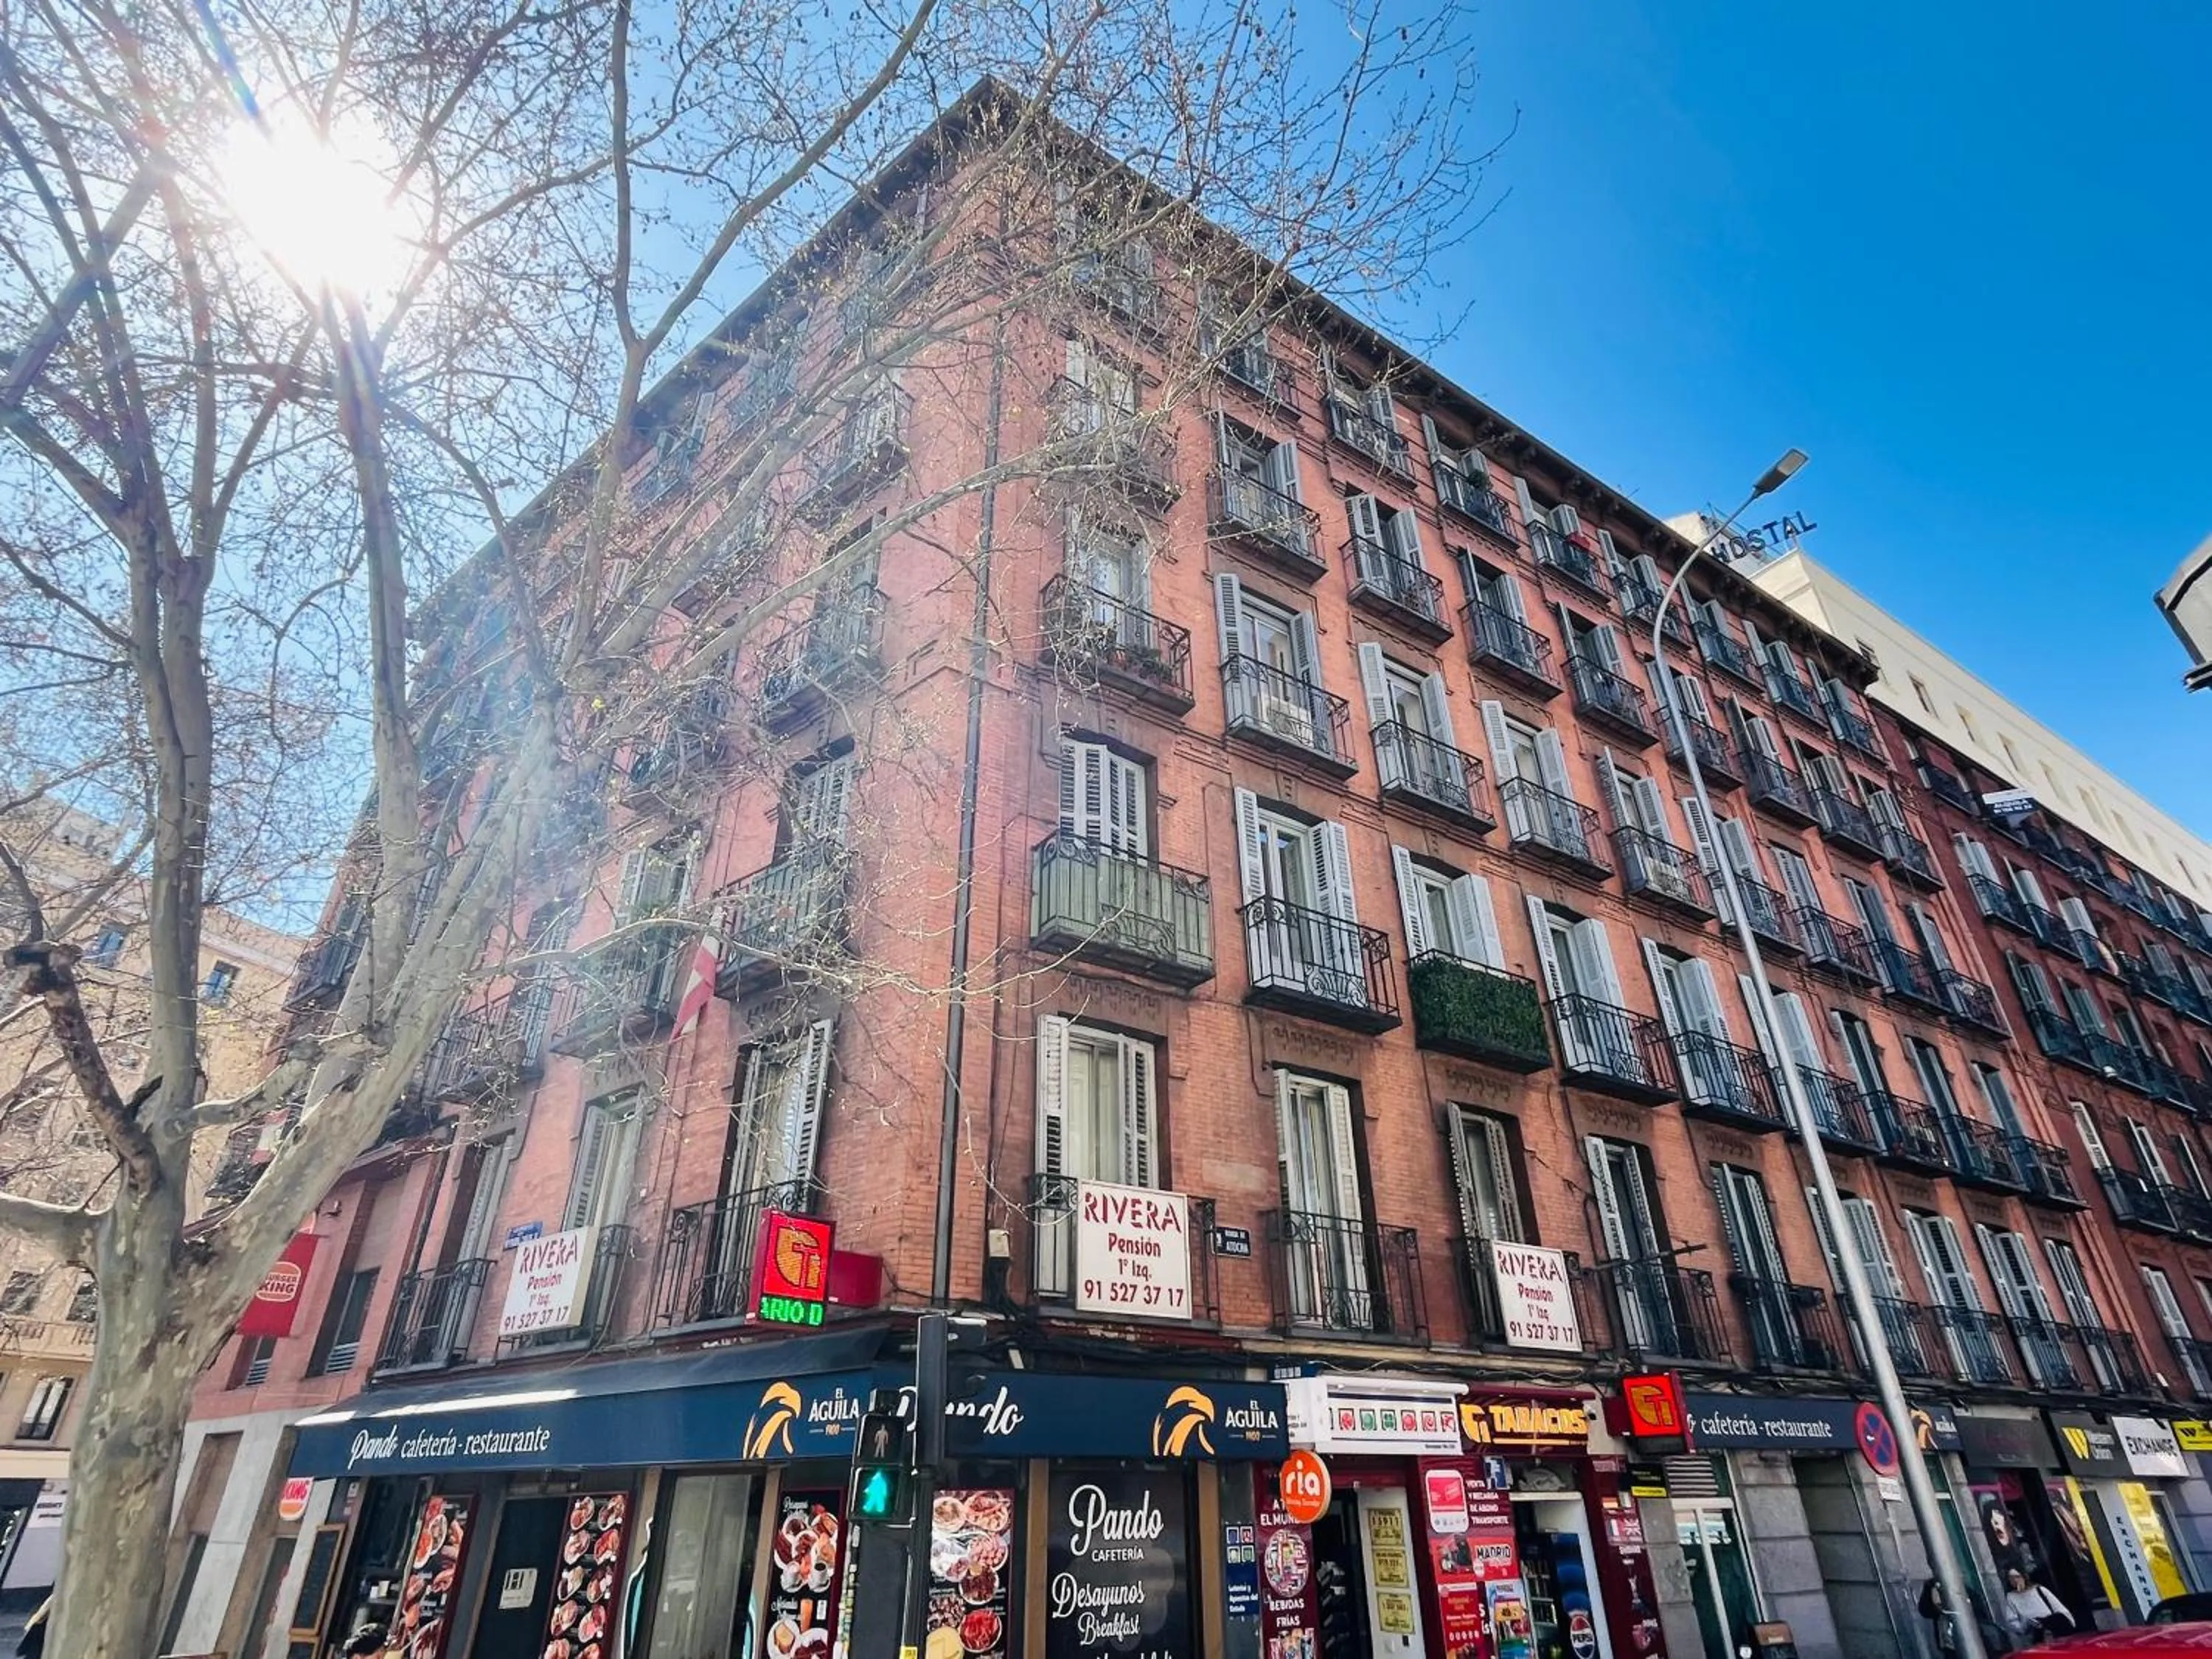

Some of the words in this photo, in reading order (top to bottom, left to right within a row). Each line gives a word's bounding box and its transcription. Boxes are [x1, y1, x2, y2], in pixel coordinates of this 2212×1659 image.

[1710, 510, 1818, 563] HOSTAL
[1085, 1192, 1182, 1234] RIVERA
[519, 1234, 578, 1275] RIVERA
[1108, 1232, 1161, 1258] Pensión
[1226, 1241, 1249, 1254] ATOCHA
[268, 1273, 297, 1283] URGER
[1132, 1259, 1152, 1281] Izq.
[1498, 1249, 1564, 1284] RIVERA
[526, 1271, 563, 1291] Pensión
[1517, 1282, 1554, 1303] Pensión
[1084, 1279, 1102, 1300] 91
[1110, 1281, 1138, 1303] 527
[1144, 1285, 1162, 1305] 37
[1168, 1287, 1184, 1307] 17
[504, 1315, 515, 1331] 91
[518, 1311, 538, 1329] 527
[539, 1308, 554, 1326] 37
[555, 1305, 569, 1322] 17
[1509, 1321, 1523, 1338] 91
[1526, 1323, 1544, 1340] 527
[1548, 1324, 1559, 1341] 37
[1562, 1326, 1573, 1343] 17
[835, 1387, 844, 1399] EL
[807, 1398, 860, 1422] ÁGUILA
[1249, 1399, 1259, 1411] EL
[1225, 1406, 1279, 1429] ÁGUILA
[1488, 1405, 1589, 1435] TABACOS
[1701, 1411, 1759, 1436] cafetería
[1764, 1418, 1833, 1439] restaurante
[347, 1424, 400, 1471] Pando
[400, 1427, 457, 1460] cafetería
[463, 1425, 552, 1455] restaurante
[2126, 1436, 2178, 1458] EXCHANGE
[1285, 1459, 1321, 1497] ria
[1068, 1484, 1165, 1557] Pando
[1260, 1513, 1272, 1526] EL
[1091, 1545, 1144, 1562] CAFETERÍA
[1477, 1545, 1512, 1559] MADRID
[1052, 1572, 1145, 1618] Desayunos
[1269, 1598, 1305, 1612] BEBIDAS
[1077, 1611, 1141, 1646] Breakfast
[1276, 1613, 1300, 1627] FRÍAS
